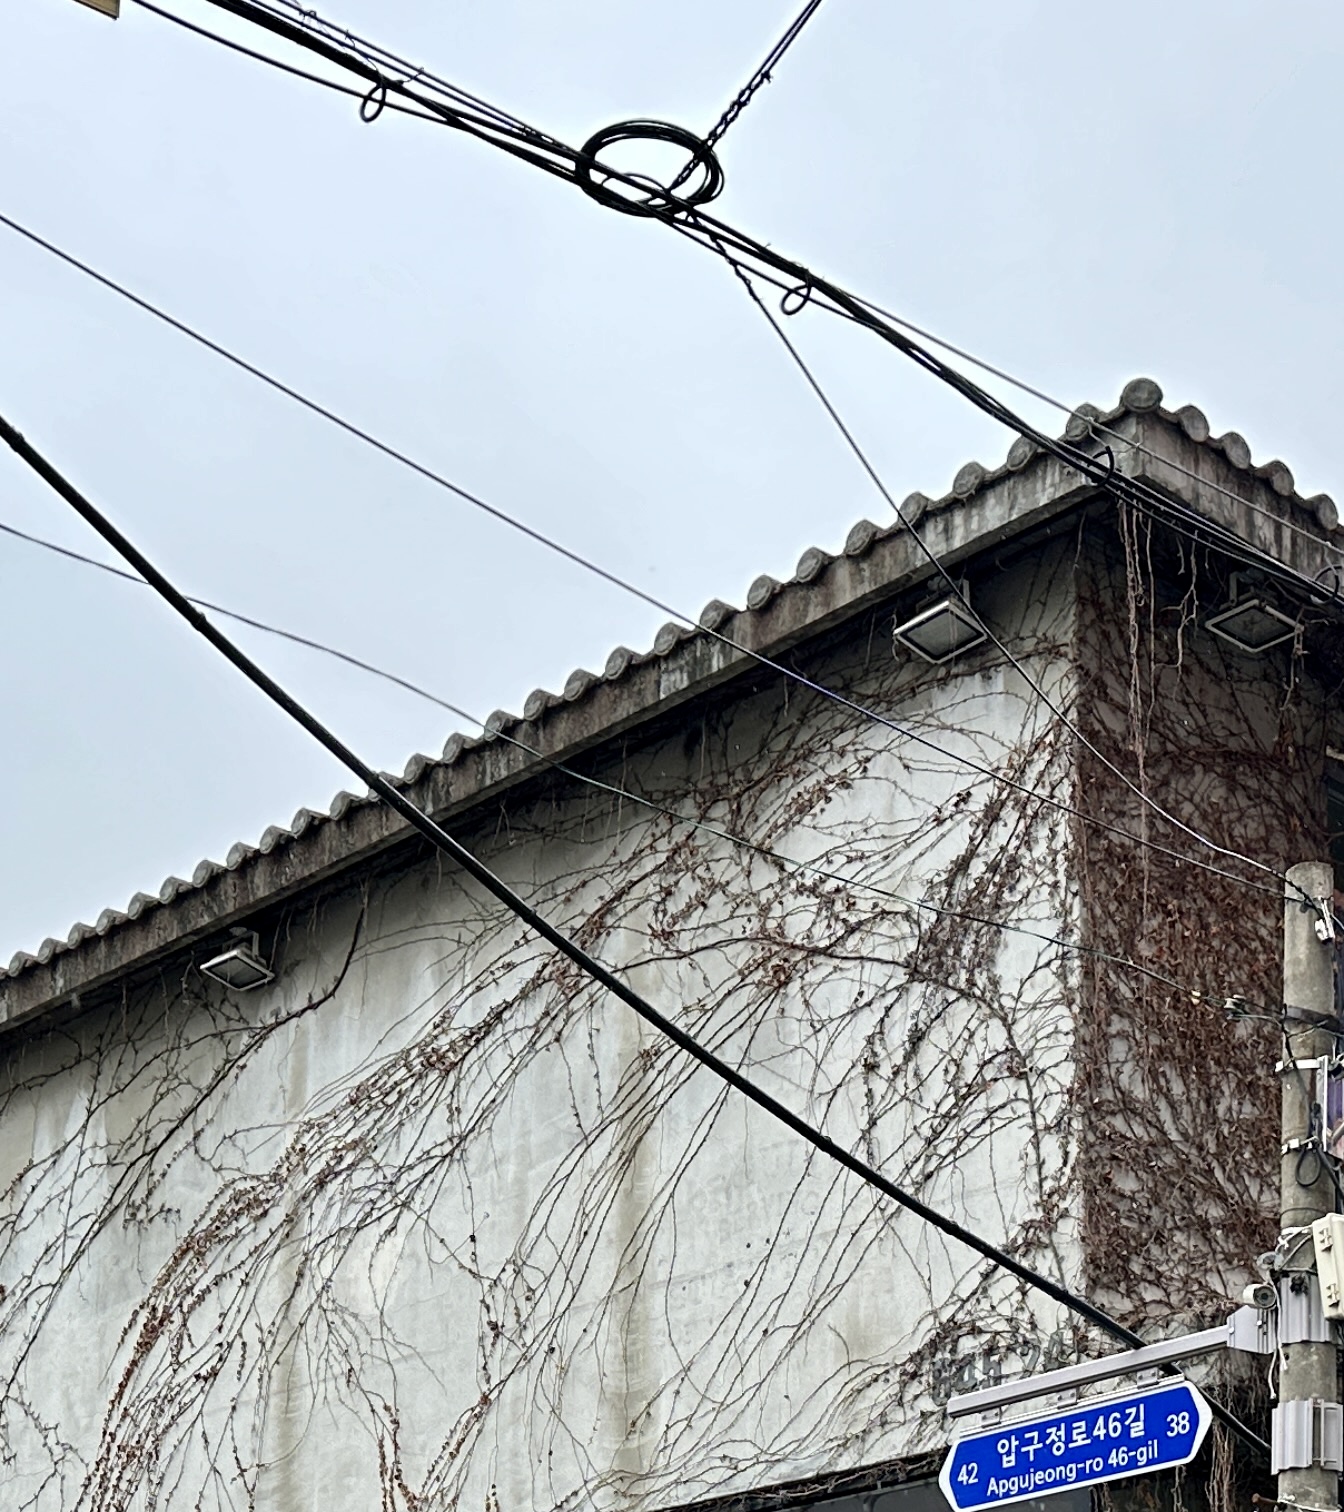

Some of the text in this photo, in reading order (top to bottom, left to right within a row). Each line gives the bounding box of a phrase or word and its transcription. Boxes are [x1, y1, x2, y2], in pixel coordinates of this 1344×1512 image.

[996, 1403, 1146, 1468] 압구정로46길
[1166, 1411, 1191, 1438] 38
[957, 1462, 979, 1486] 42
[987, 1439, 1159, 1497] Apgujeong-ro 46-gil
